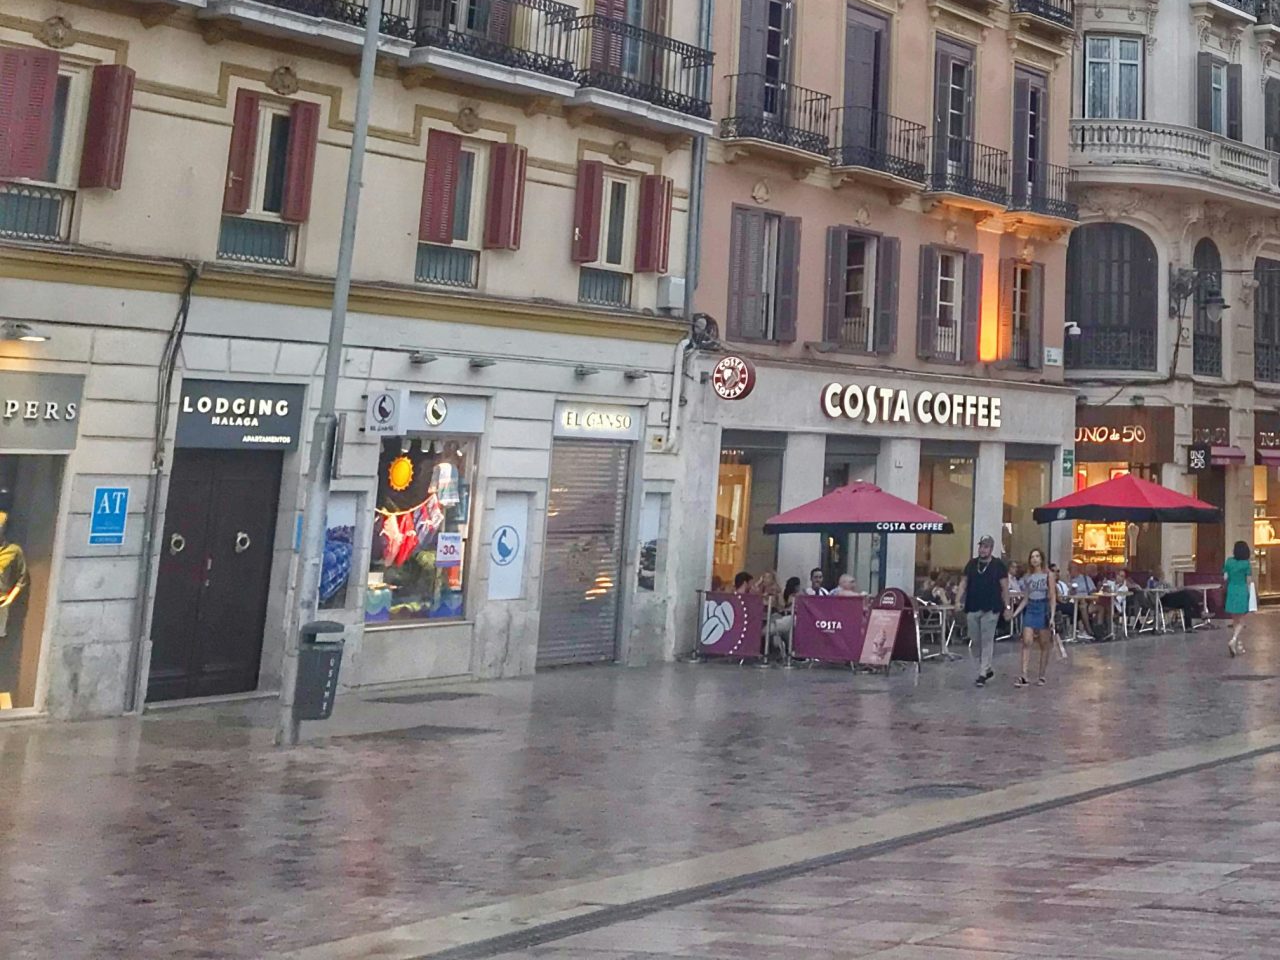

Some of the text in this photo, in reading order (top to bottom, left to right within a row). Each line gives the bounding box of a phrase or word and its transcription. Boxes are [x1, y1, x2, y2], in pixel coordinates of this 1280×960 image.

[182, 396, 289, 416] LODGING
[823, 382, 1001, 428] COSTA COFFEE
[211, 416, 259, 427] MALAGA
[566, 411, 581, 426] EL
[242, 435, 291, 443] APARTAMENTOS
[1122, 425, 1146, 442] 50
[97, 491, 126, 514] AT
[876, 522, 943, 531] COSTA COFFEE
[815, 620, 842, 630] COSTA
